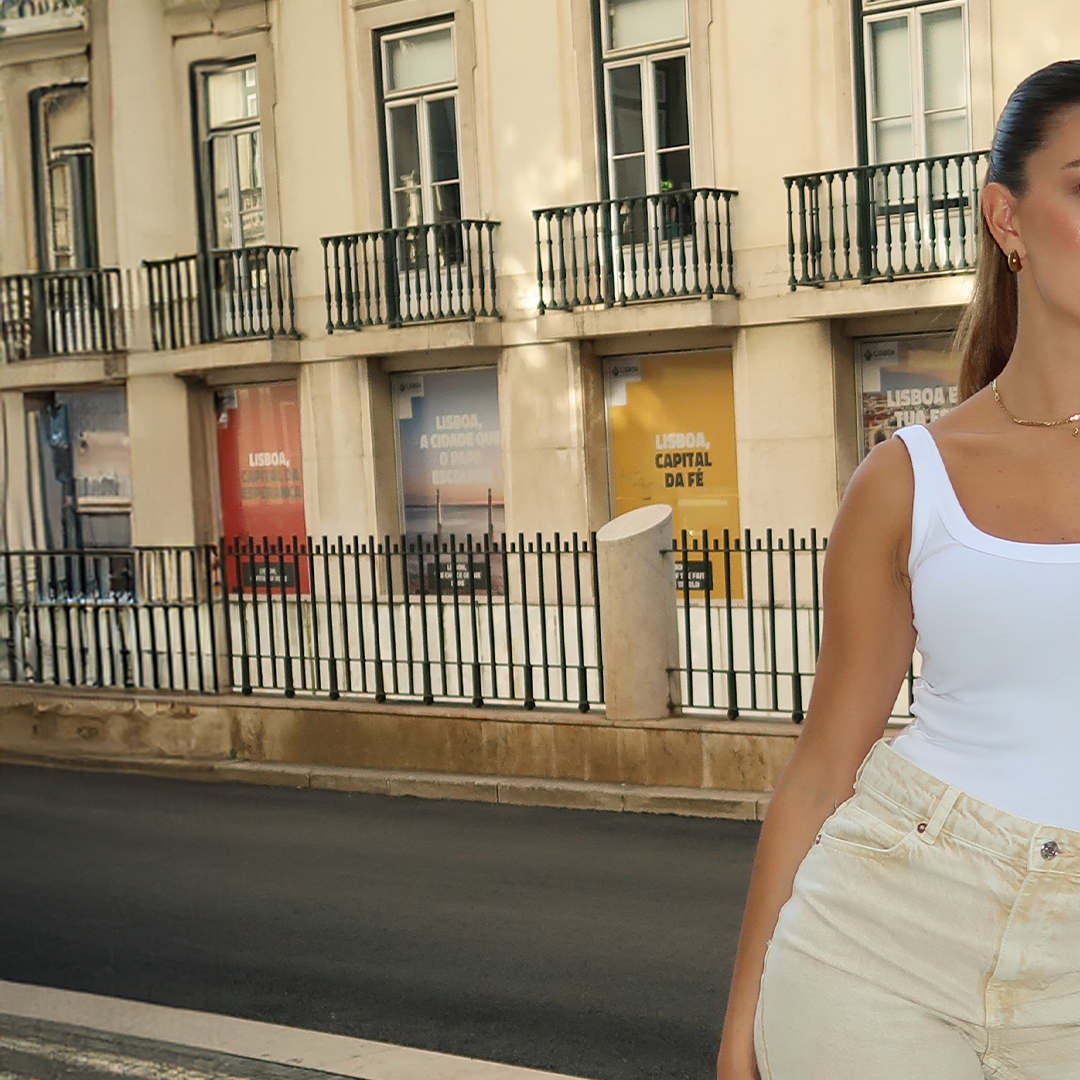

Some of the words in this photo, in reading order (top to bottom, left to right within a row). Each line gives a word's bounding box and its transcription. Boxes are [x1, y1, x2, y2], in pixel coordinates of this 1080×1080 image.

[886, 386, 945, 408] LISBOA
[435, 413, 483, 431] LISBOA,
[420, 434, 429, 449] A
[430, 431, 474, 449] CIDADE
[655, 432, 711, 450] LISBOA,
[248, 451, 291, 468] LISBOA,
[655, 451, 712, 469] CAPITAL
[664, 472, 685, 488] DA
[687, 467, 704, 487] FÉ
